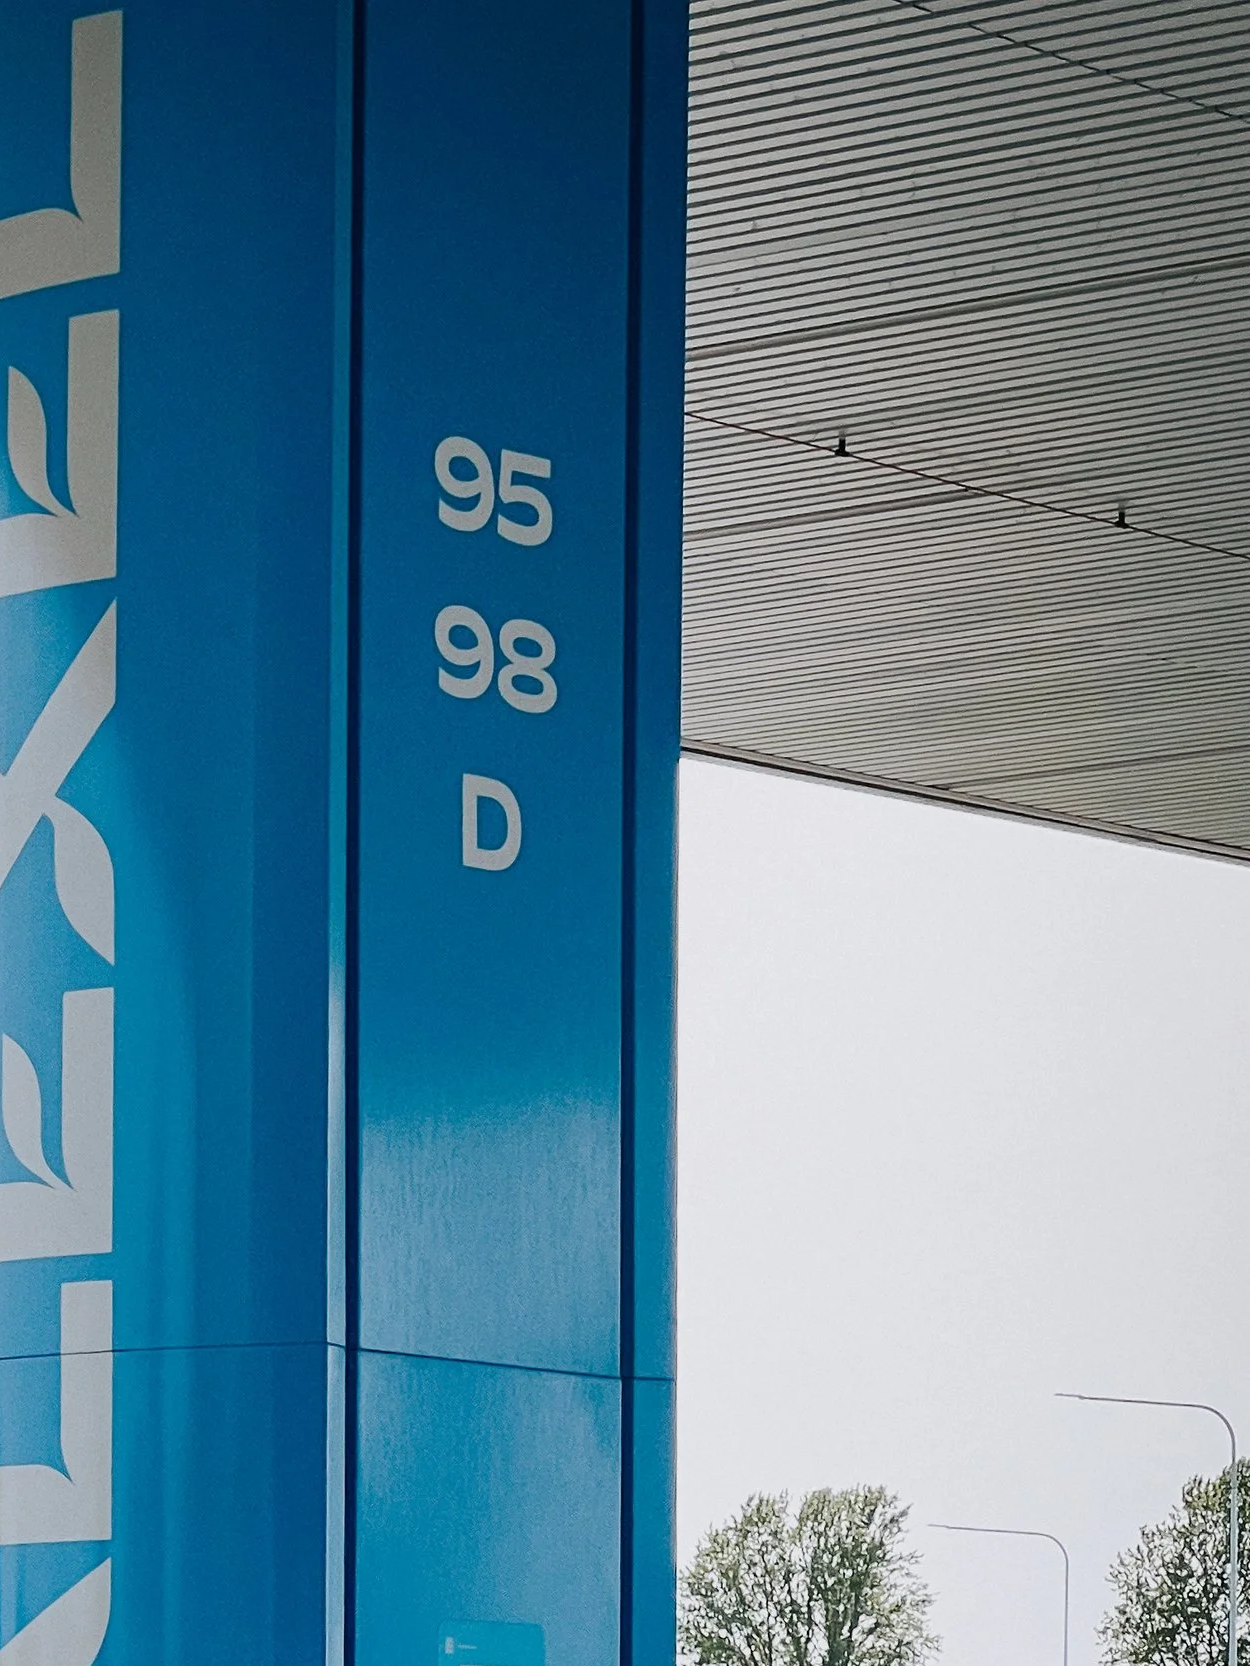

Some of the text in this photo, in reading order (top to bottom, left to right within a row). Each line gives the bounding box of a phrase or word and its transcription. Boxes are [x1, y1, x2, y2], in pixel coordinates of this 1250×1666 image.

[434, 436, 553, 547] 95
[434, 604, 558, 714] 98
[461, 773, 522, 871] D
